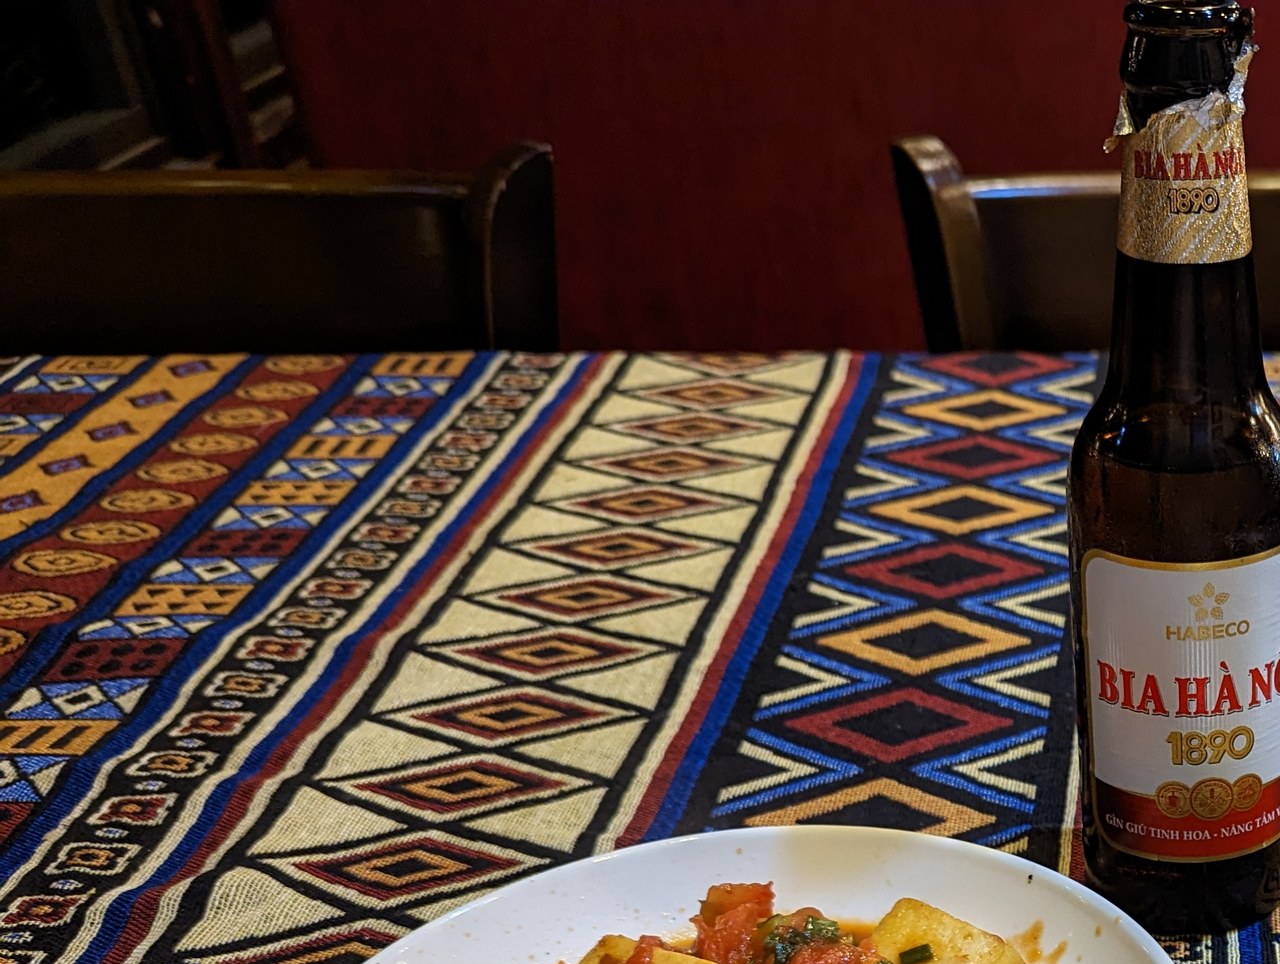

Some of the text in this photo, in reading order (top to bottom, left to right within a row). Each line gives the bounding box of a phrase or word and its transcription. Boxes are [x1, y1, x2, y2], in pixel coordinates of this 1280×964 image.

[1172, 142, 1211, 181] HÀ
[1168, 187, 1219, 214] 1890
[1165, 620, 1250, 641] HABECO
[1097, 659, 1169, 717] BIA
[1173, 660, 1243, 718] HÀ
[1165, 725, 1254, 766] 1890
[1149, 826, 1179, 840] TINH
[1183, 829, 1212, 841] HOA
